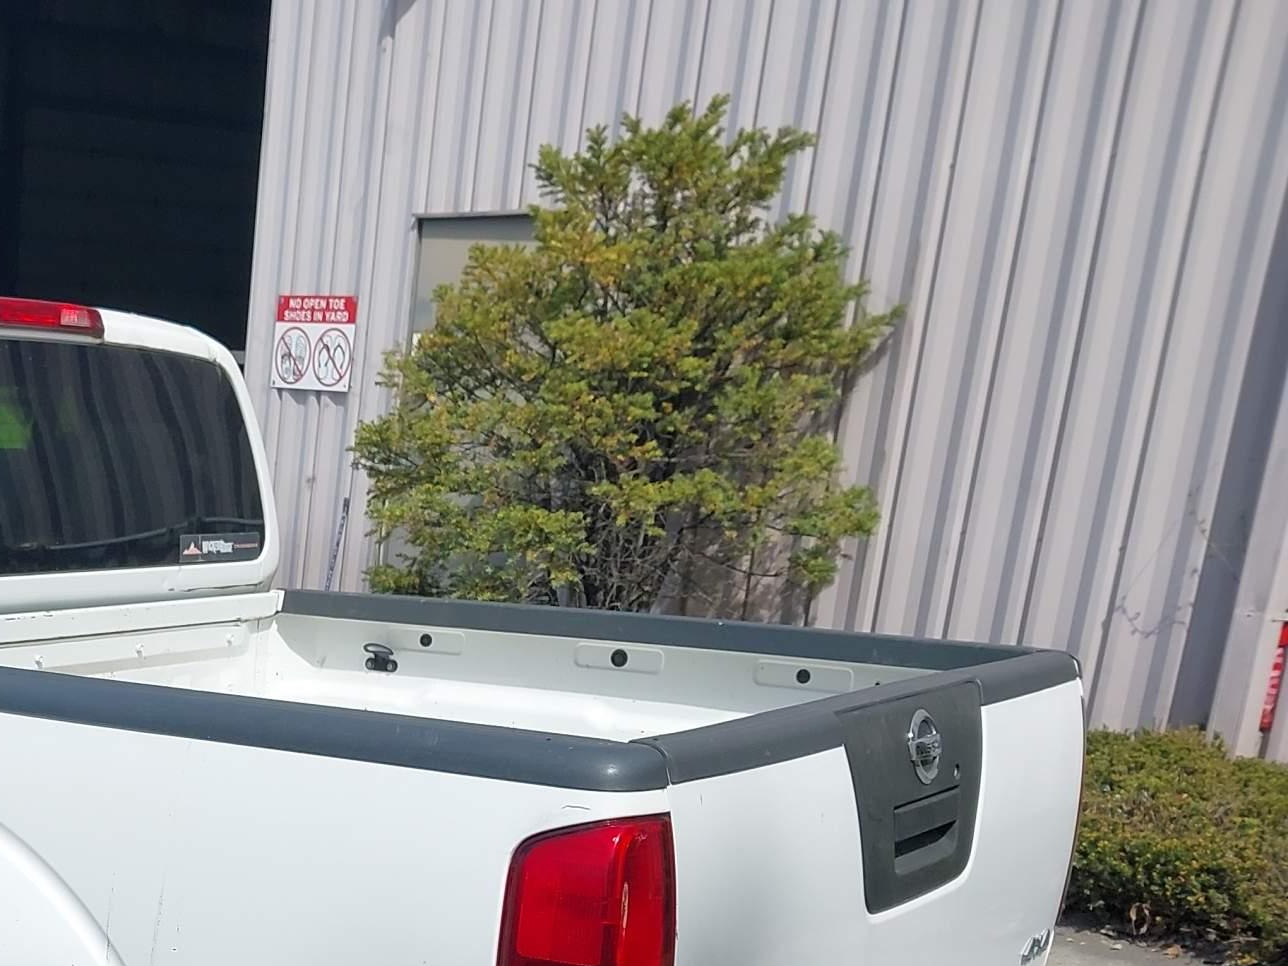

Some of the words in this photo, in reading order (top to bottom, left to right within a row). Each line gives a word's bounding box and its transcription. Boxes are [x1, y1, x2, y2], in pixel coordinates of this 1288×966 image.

[289, 298, 302, 309] NO
[303, 298, 327, 310] OPEN
[328, 299, 346, 310] TOE
[283, 310, 312, 321] SHOES
[313, 311, 324, 321] IN
[324, 311, 350, 322] YARD
